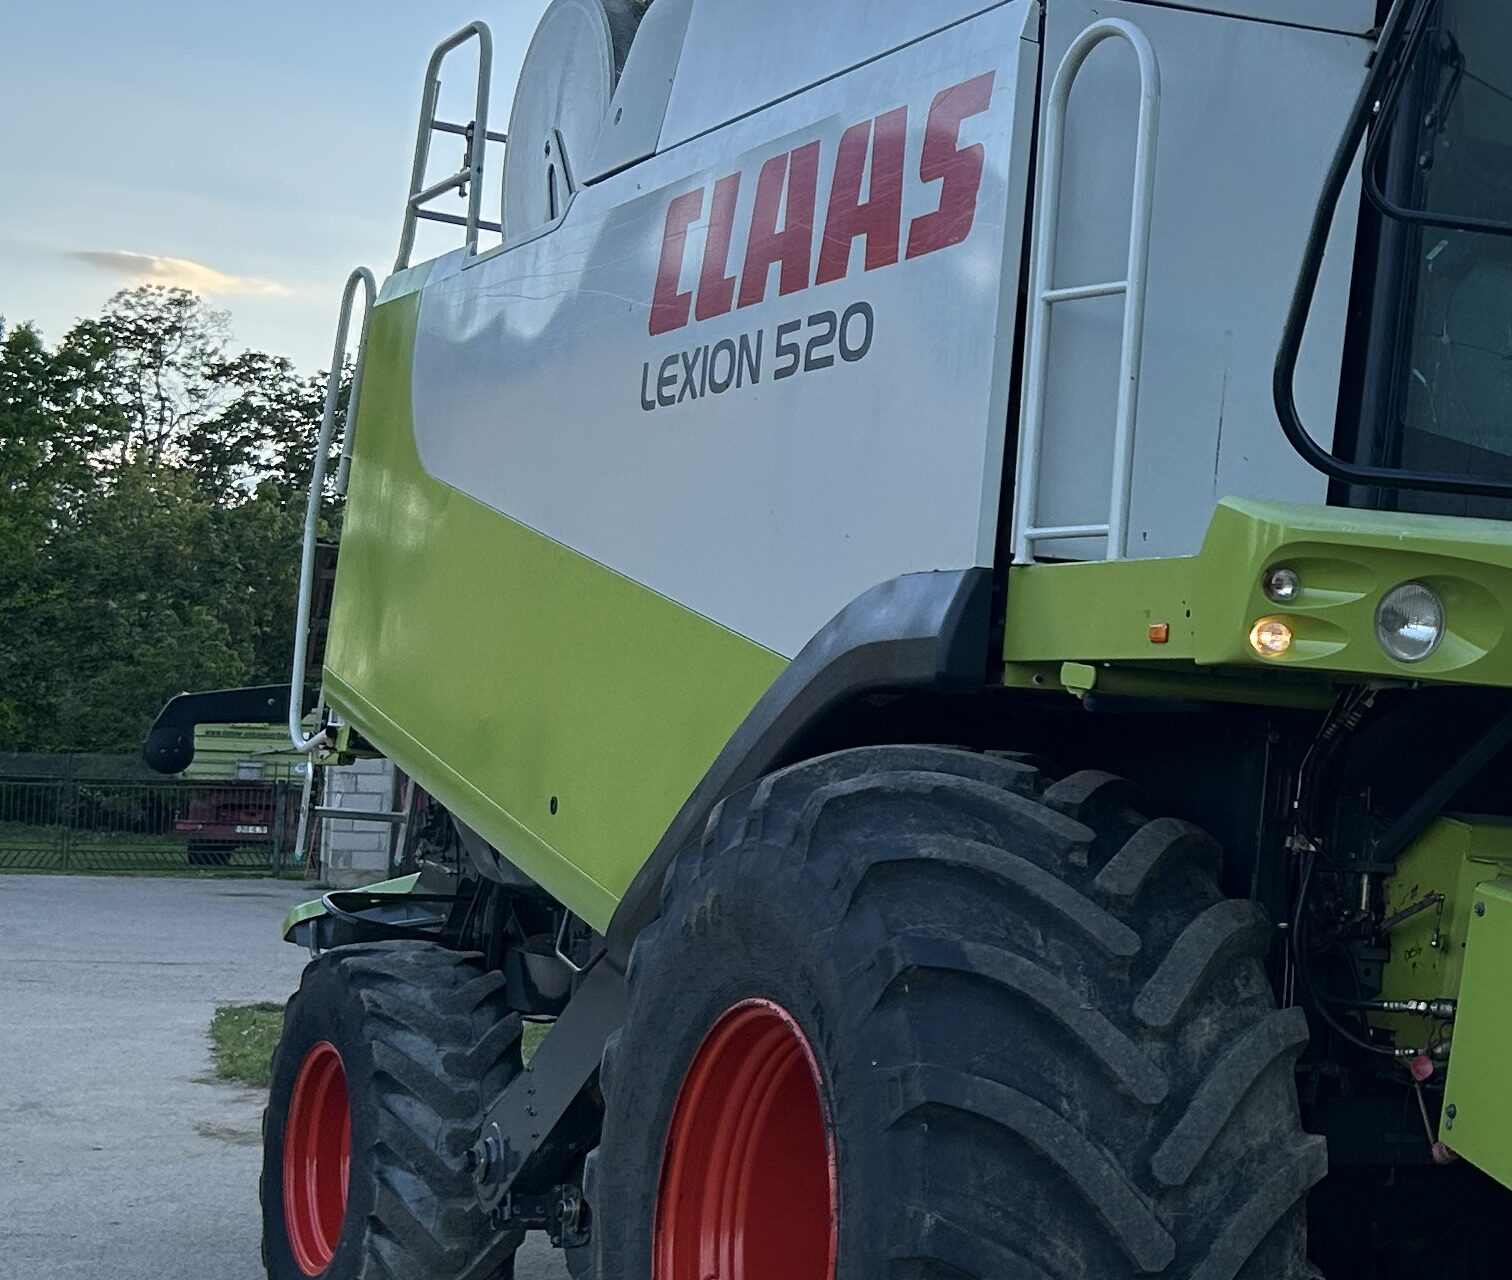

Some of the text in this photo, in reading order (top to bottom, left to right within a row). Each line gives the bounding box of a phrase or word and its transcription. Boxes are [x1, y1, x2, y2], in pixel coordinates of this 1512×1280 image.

[648, 70, 996, 336] CLAAS
[640, 301, 874, 411] LEXION 520
